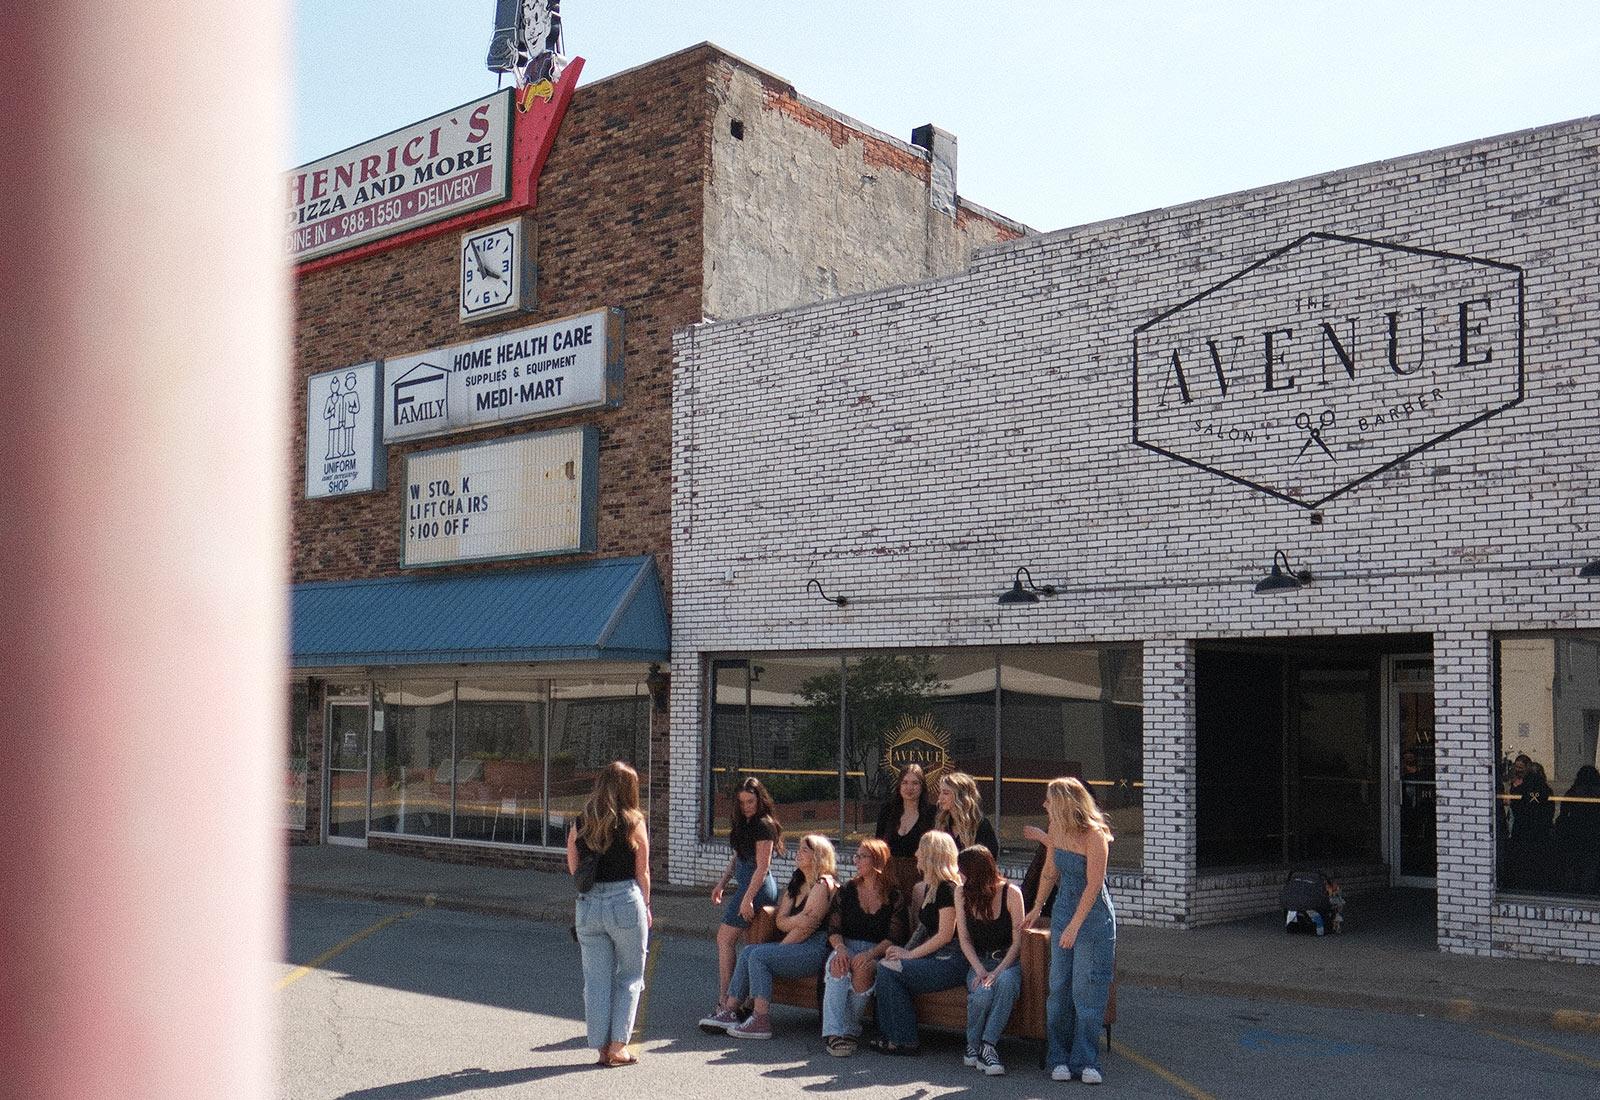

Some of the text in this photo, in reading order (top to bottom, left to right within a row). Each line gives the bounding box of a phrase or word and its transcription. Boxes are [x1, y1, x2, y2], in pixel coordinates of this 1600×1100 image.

[287, 142, 492, 226] PIZZA AND MORE
[315, 223, 328, 245] IN
[341, 200, 401, 236] 988-1550
[418, 172, 480, 213] DELIVERY
[482, 237, 494, 252] 12
[466, 259, 510, 283] 9 3
[483, 291, 490, 304] 6
[453, 325, 593, 373] HOME HEALTH CARE
[1158, 298, 1493, 407] AVENUE
[465, 354, 577, 387] SUPPLIES & EQUIPMENT
[393, 373, 446, 426] FAMILY
[476, 377, 565, 411] MEDI-MART
[1194, 389, 1444, 442] SALON BARBER
[323, 459, 356, 475] UNIFORM
[328, 479, 349, 493] SHOP
[410, 518, 470, 540] $100 OFF
[895, 750, 942, 762] AVENUE
